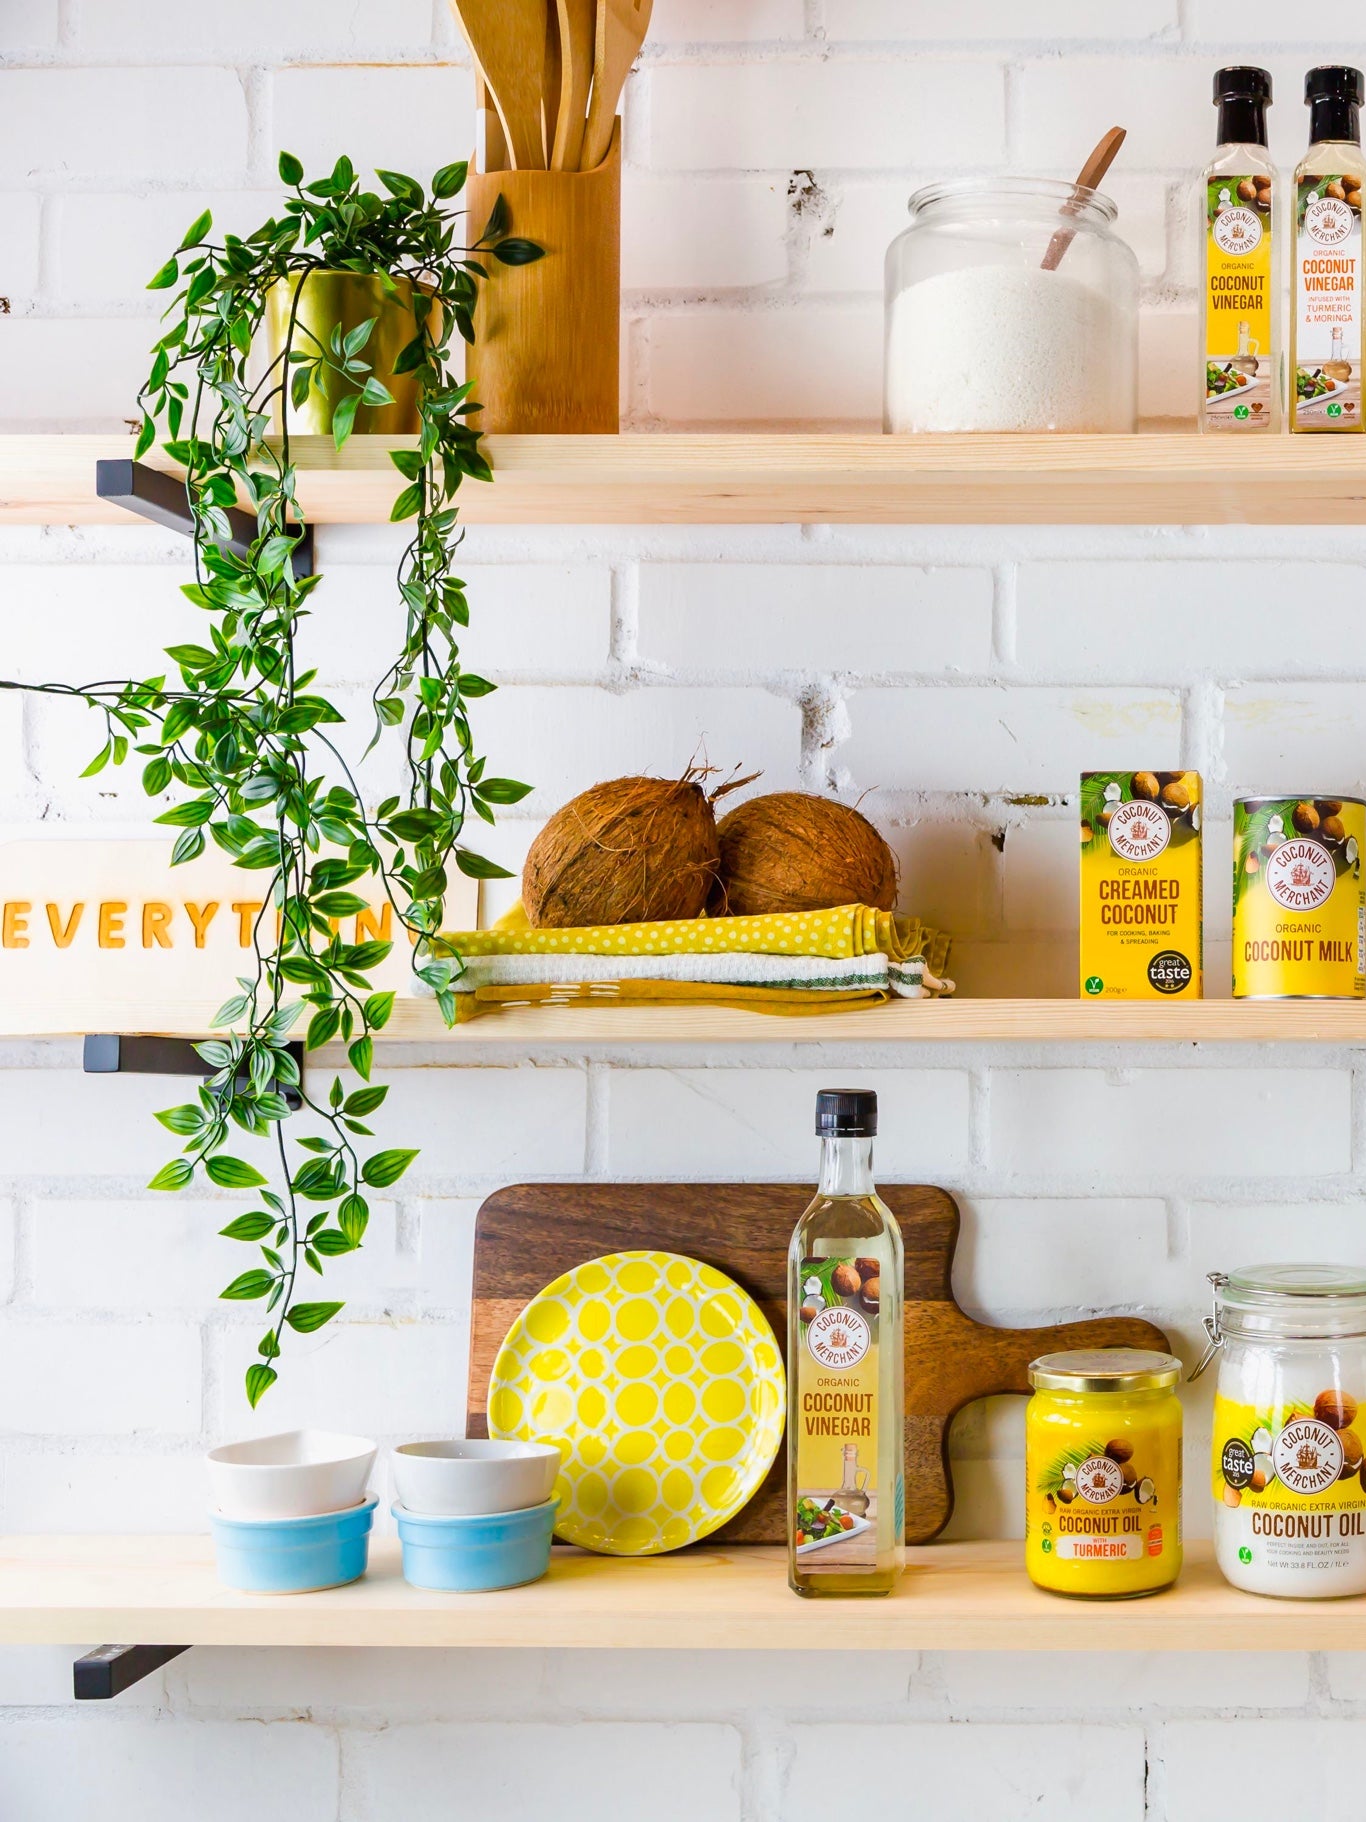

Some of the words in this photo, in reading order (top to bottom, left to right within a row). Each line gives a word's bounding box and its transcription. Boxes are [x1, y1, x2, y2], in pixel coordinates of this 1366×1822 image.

[1311, 201, 1347, 218] COCONUT
[1220, 211, 1256, 227] COCONUT
[1311, 225, 1348, 242] MERCHANT
[1220, 234, 1257, 252] MERCHANT
[1302, 259, 1356, 274] COCONUT
[1211, 275, 1265, 291] COCONUT
[1304, 276, 1354, 291] VINEGAR
[1212, 294, 1263, 310] VINEGAR
[1307, 304, 1351, 312] TURMERIC
[1313, 314, 1353, 322] MORINGA
[1117, 805, 1163, 825] COCONUT
[1115, 834, 1164, 857] MERCHANT
[1276, 844, 1328, 868] COCONUT
[1118, 868, 1158, 876] ORGANIC
[1099, 879, 1180, 900] CREAMED
[1274, 879, 1329, 906] MERCHANT
[1101, 904, 1178, 925] COCONUT
[1, 901, 424, 949] EVERYTIN
[1275, 923, 1322, 933] ORGANIC
[1244, 940, 1314, 962] COCONUT
[1319, 940, 1353, 963] MILK
[1158, 959, 1180, 968] great
[1150, 967, 1190, 979] taste
[816, 1313, 863, 1333] COCONUT
[814, 1341, 865, 1365] MERCHANT
[816, 1378, 860, 1387] ORGANIC
[803, 1392, 874, 1413] COCONUT
[805, 1416, 871, 1437] VINEGAR
[1282, 1426, 1334, 1449] COCONUT
[1228, 1448, 1246, 1458] great
[1082, 1460, 1117, 1476] COCONUT
[1223, 1455, 1253, 1474] taste
[1280, 1461, 1337, 1490] MERCHANT
[1081, 1483, 1119, 1501] MERCHANT
[1251, 1500, 1268, 1508] RAW
[1270, 1502, 1306, 1511] ORGANIC
[1309, 1502, 1337, 1511] EXTRA
[1339, 1500, 1366, 1509] VIRGIN
[1059, 1515, 1119, 1534] COCONUT
[1122, 1515, 1142, 1532] OIL
[1252, 1512, 1334, 1538] COCONUT
[1339, 1513, 1365, 1536] OIL
[1073, 1543, 1127, 1557] TURMERIC
